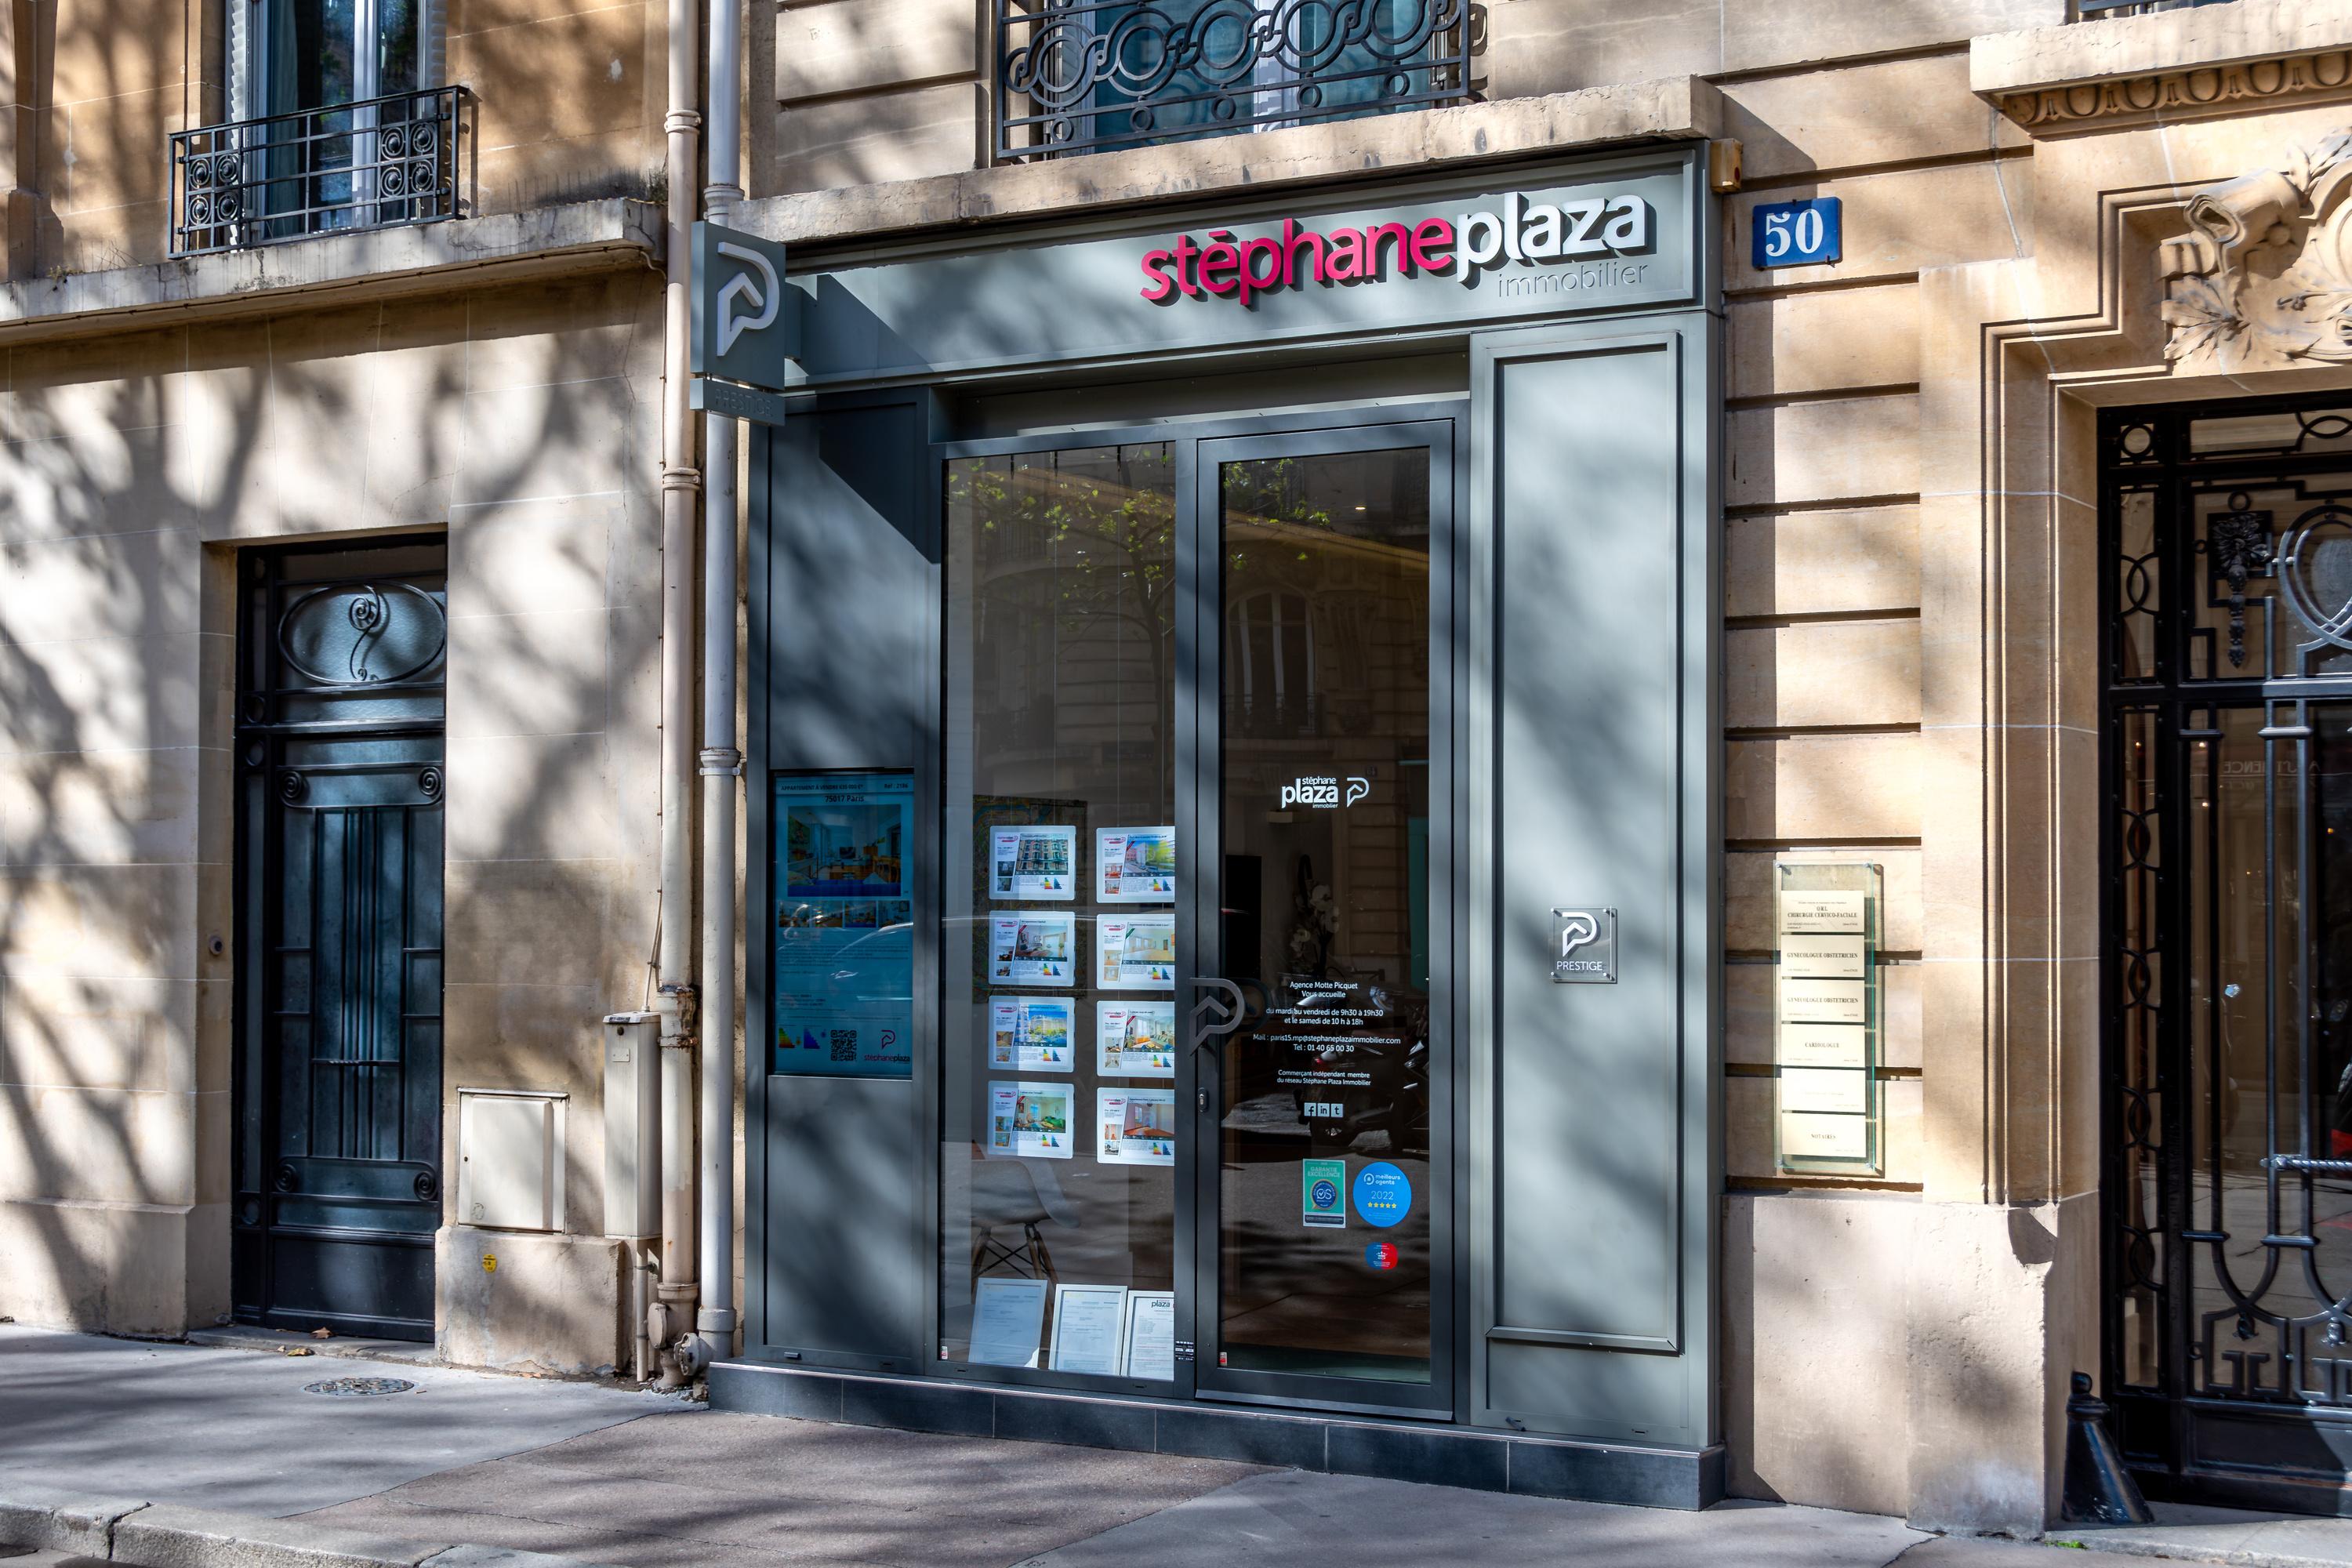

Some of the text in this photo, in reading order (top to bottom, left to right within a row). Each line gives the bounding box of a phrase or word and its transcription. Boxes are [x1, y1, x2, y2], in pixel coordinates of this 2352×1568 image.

[1766, 209, 1824, 257] 50
[1498, 262, 1648, 298] immobilier
[1281, 779, 1338, 808] plaza
[1556, 961, 1602, 971] PRESTIGE
[1334, 982, 1358, 990] Picquet
[1270, 1035, 1401, 1044] paris15.mp@stephaneplazaimmobilier.com
[1278, 1069, 1312, 1078] Commerçant
[1371, 1190, 1394, 1200] 2022
[1151, 1299, 1171, 1308] plaza
